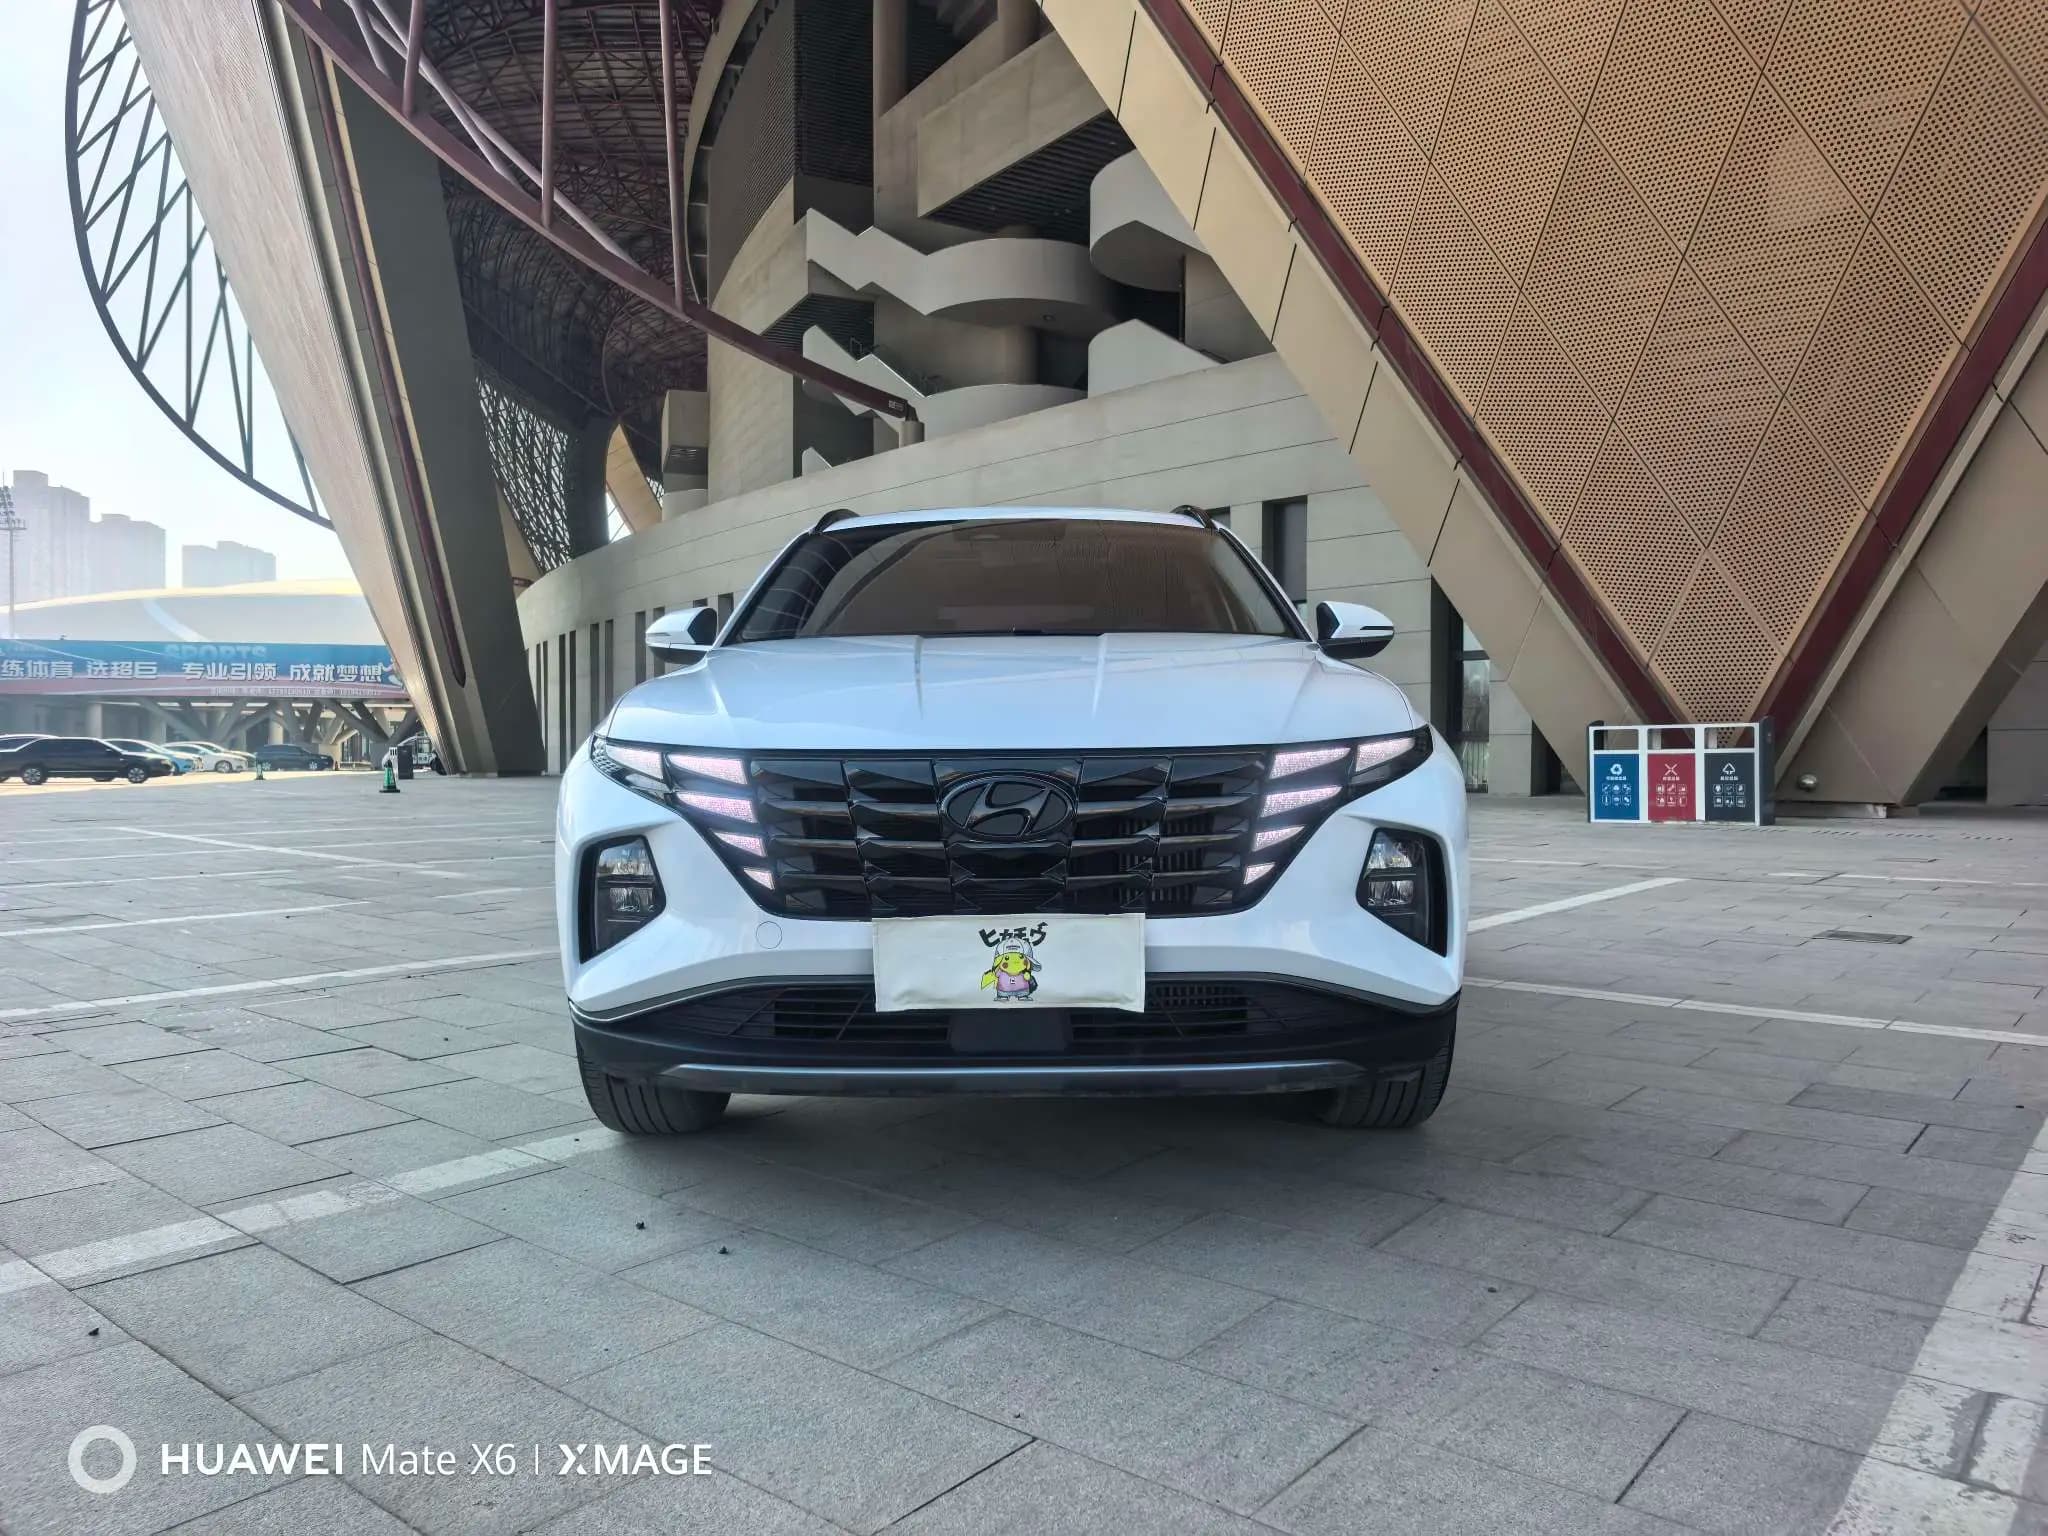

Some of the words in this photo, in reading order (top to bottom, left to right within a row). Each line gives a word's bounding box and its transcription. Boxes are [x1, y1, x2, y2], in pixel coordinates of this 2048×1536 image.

[1, 659, 74, 679] 练体育
[86, 660, 158, 680] 选超巨
[182, 662, 279, 682] 专业引领
[289, 663, 383, 684] 成就梦想
